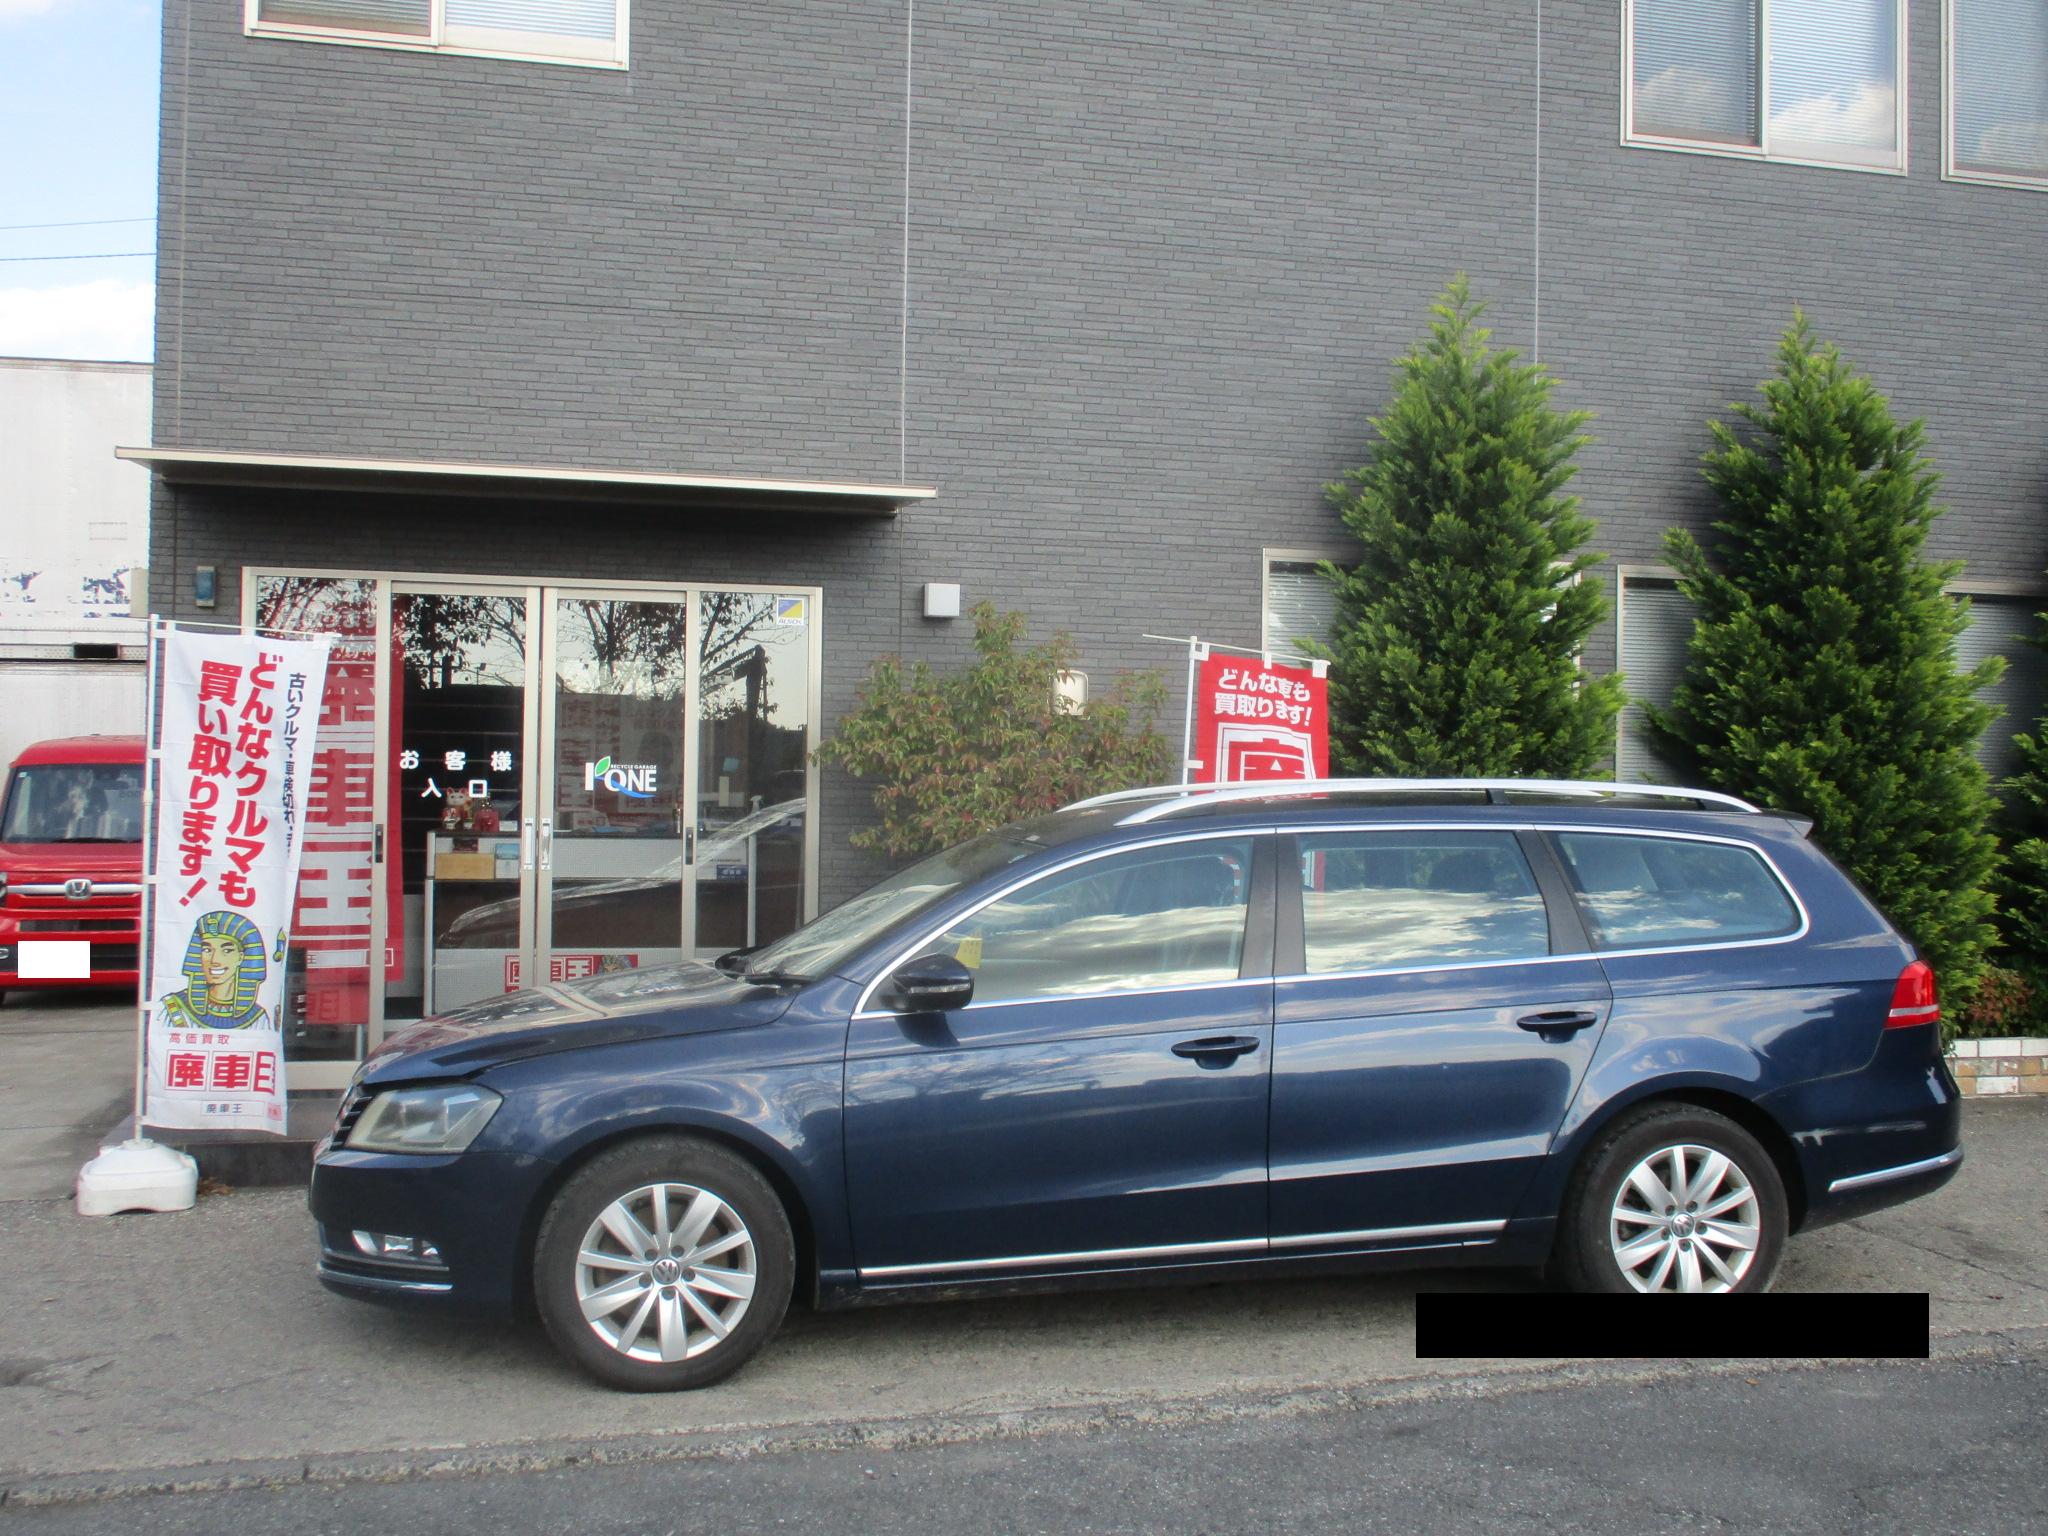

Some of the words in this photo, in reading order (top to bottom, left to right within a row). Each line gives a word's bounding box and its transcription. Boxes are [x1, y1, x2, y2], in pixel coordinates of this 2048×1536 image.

[1218, 668, 1311, 702] どんな車も
[1214, 692, 1313, 727] 買取ります!
[399, 750, 512, 771] お客様
[178, 660, 243, 907] 買い取ります!
[218, 652, 284, 908] どんなクルマも
[421, 778, 488, 798] 入口
[168, 1033, 230, 1045] 高価買取
